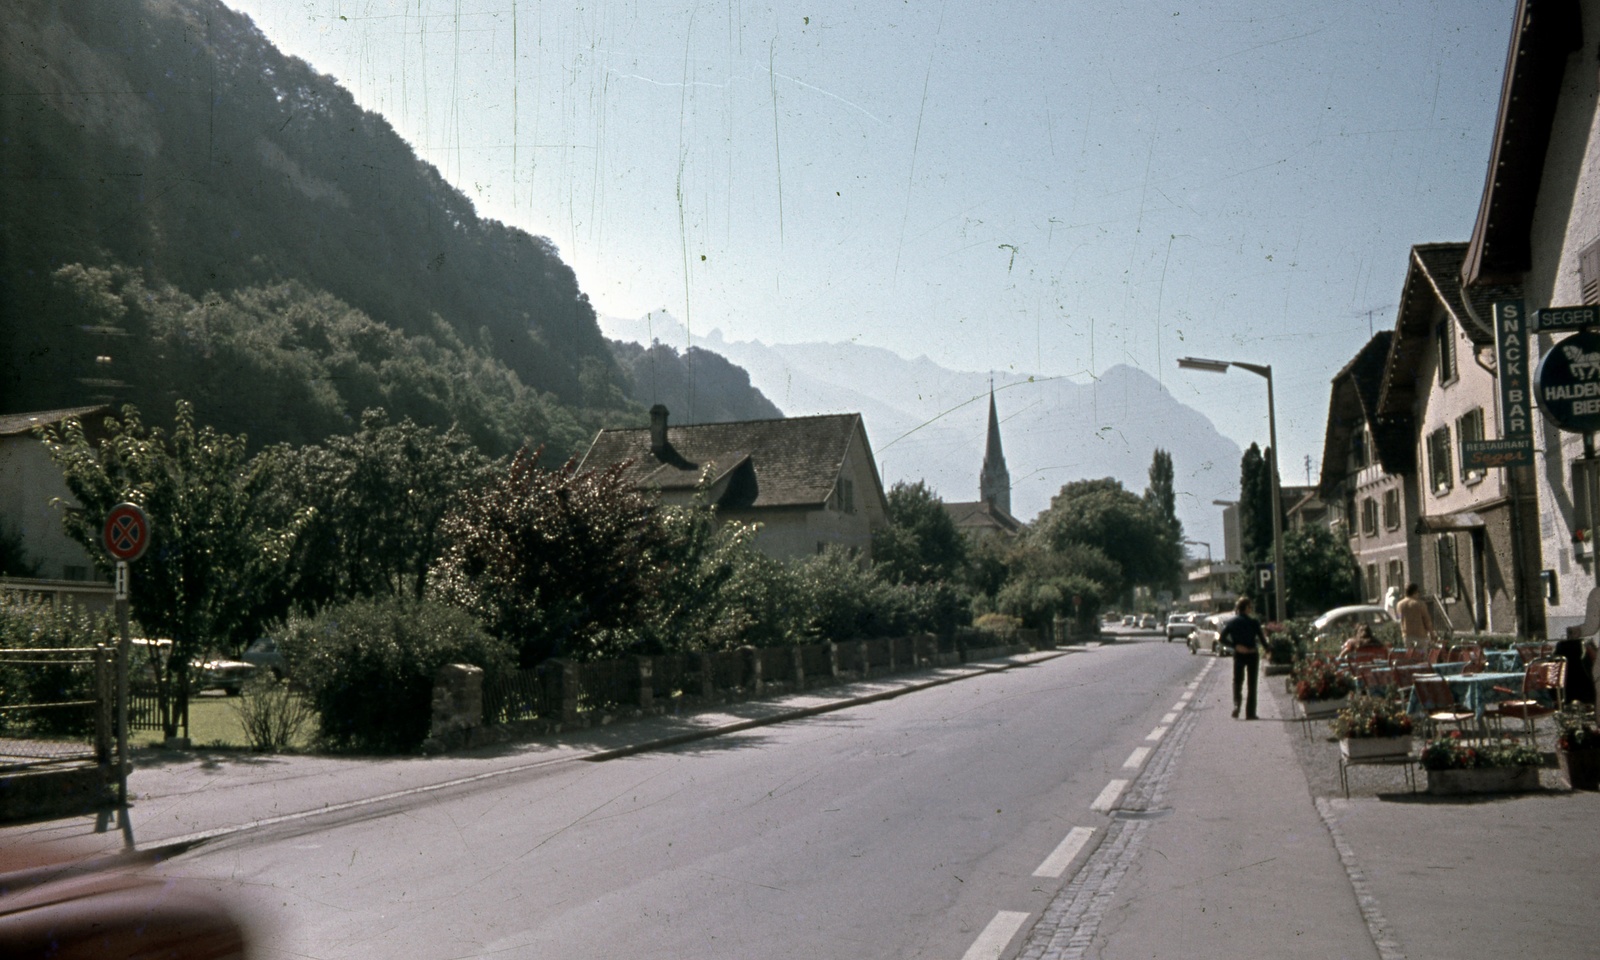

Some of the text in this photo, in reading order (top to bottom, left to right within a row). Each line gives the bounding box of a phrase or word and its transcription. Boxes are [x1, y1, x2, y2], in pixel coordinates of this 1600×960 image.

[1541, 309, 1594, 326] SEGER
[1503, 304, 1525, 431] SNACK BAR
[1466, 440, 1530, 452] RESTAURANT
[1260, 569, 1271, 588] P
